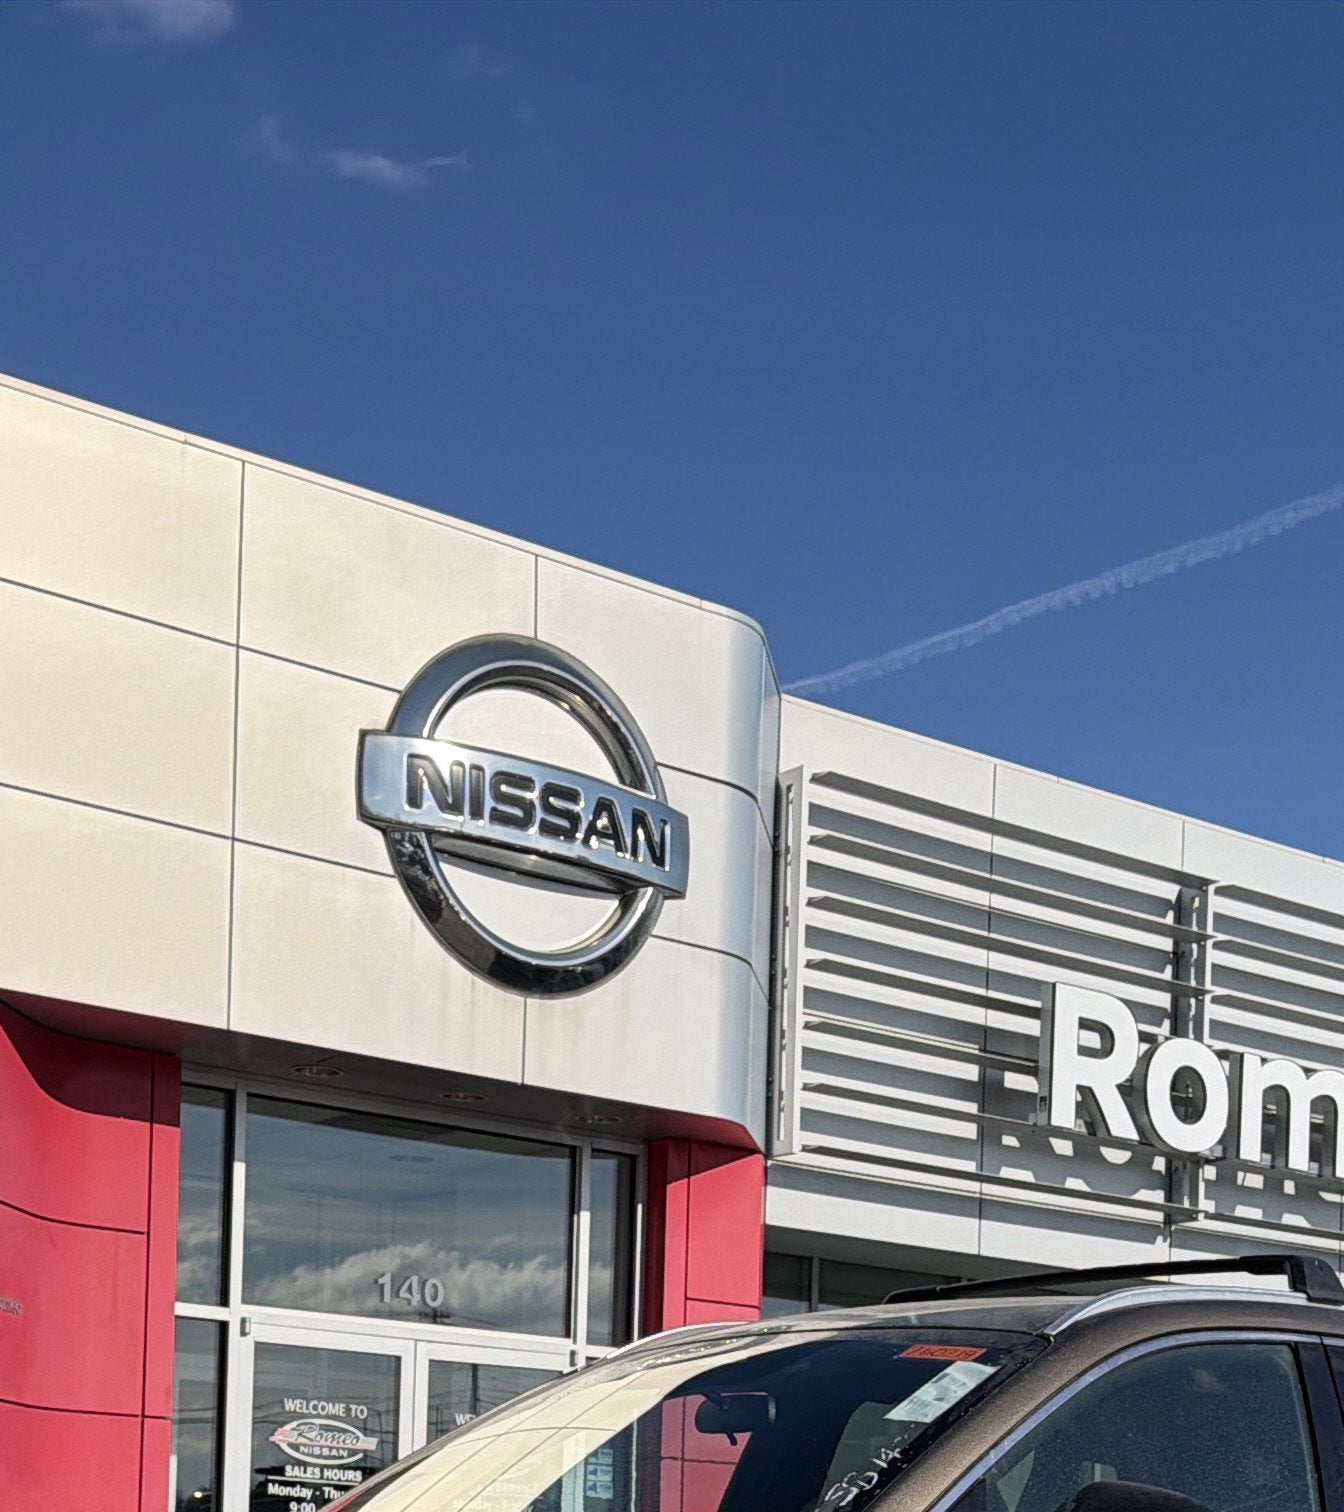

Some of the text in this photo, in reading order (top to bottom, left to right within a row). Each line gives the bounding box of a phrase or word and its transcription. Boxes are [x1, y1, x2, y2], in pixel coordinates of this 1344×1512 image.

[405, 752, 671, 872] NISSAN
[376, 1271, 444, 1308] 140
[284, 1397, 368, 1419] WELCOME TO
[291, 1421, 360, 1446] Romeo
[299, 1446, 348, 1458] NISSAN
[285, 1465, 363, 1482] SALES HOURS
[267, 1483, 313, 1500] Monday
